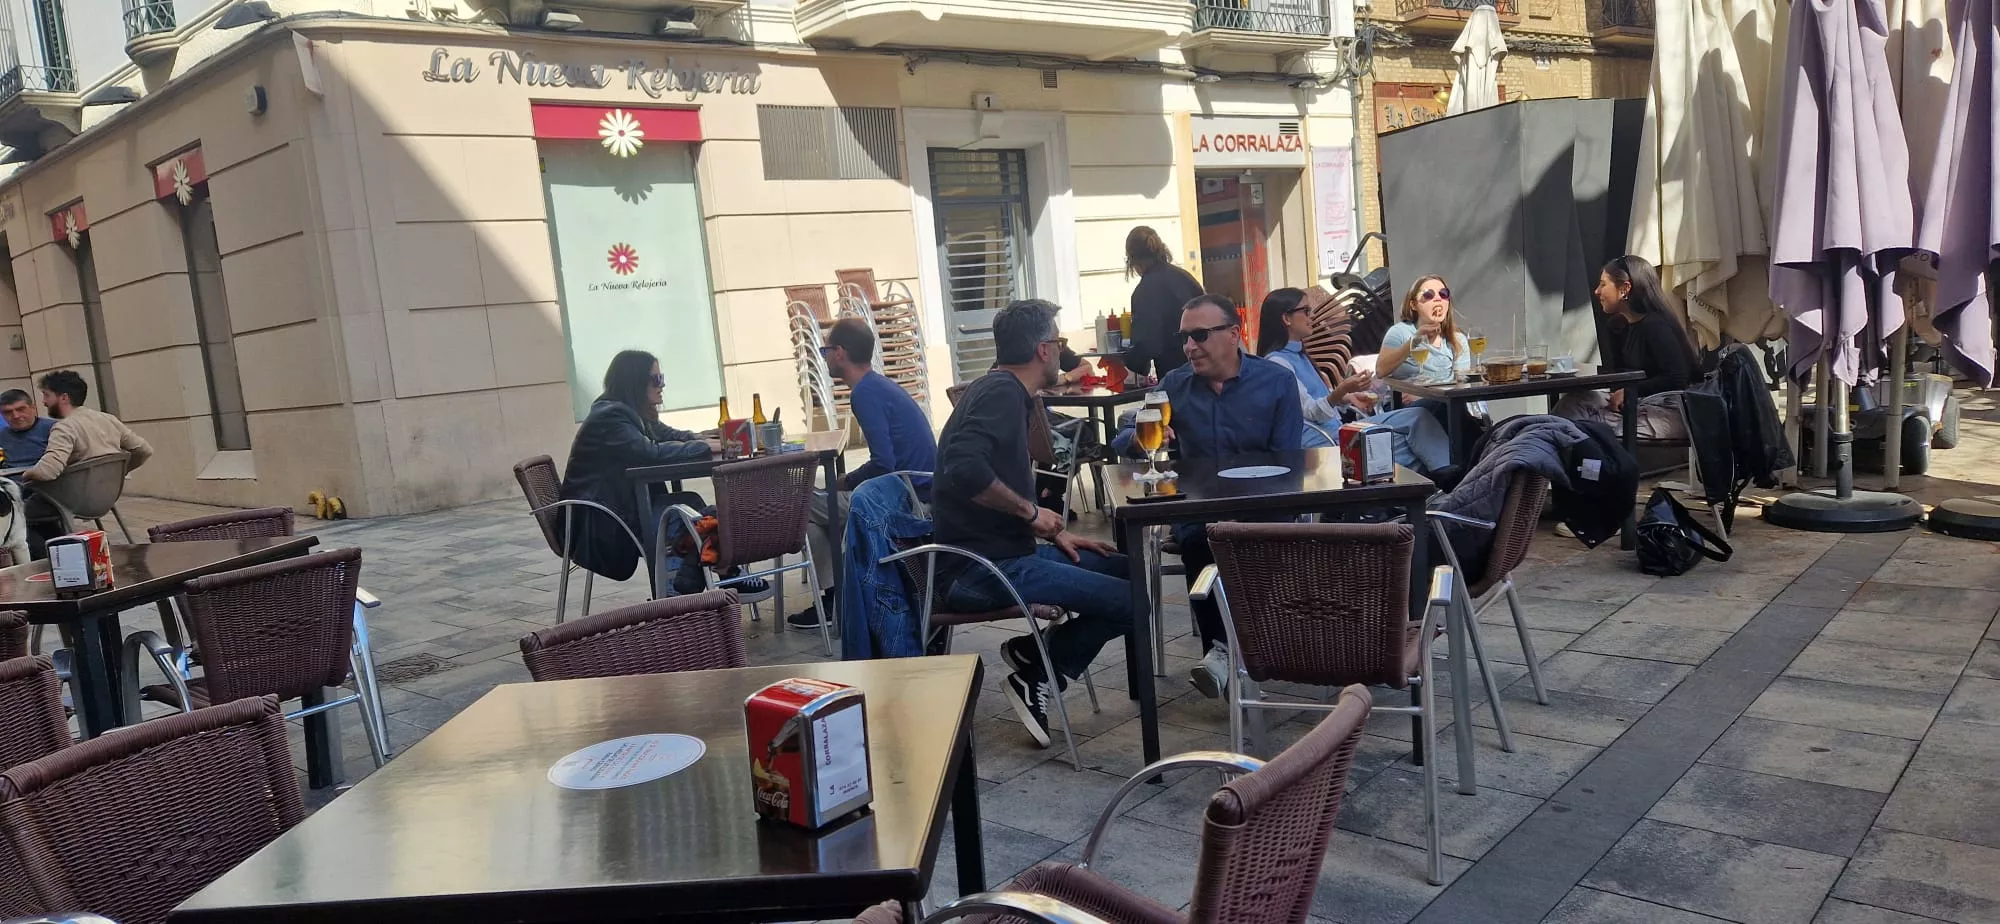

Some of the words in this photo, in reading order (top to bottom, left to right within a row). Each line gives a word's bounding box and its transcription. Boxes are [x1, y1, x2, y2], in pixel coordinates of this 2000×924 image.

[422, 47, 480, 83] La
[488, 50, 611, 89] Nueva
[984, 96, 991, 108] 1
[1191, 134, 1209, 152] LA
[1213, 134, 1303, 152] CORRALAZA
[588, 283, 598, 291] La
[600, 281, 628, 291] Nueva
